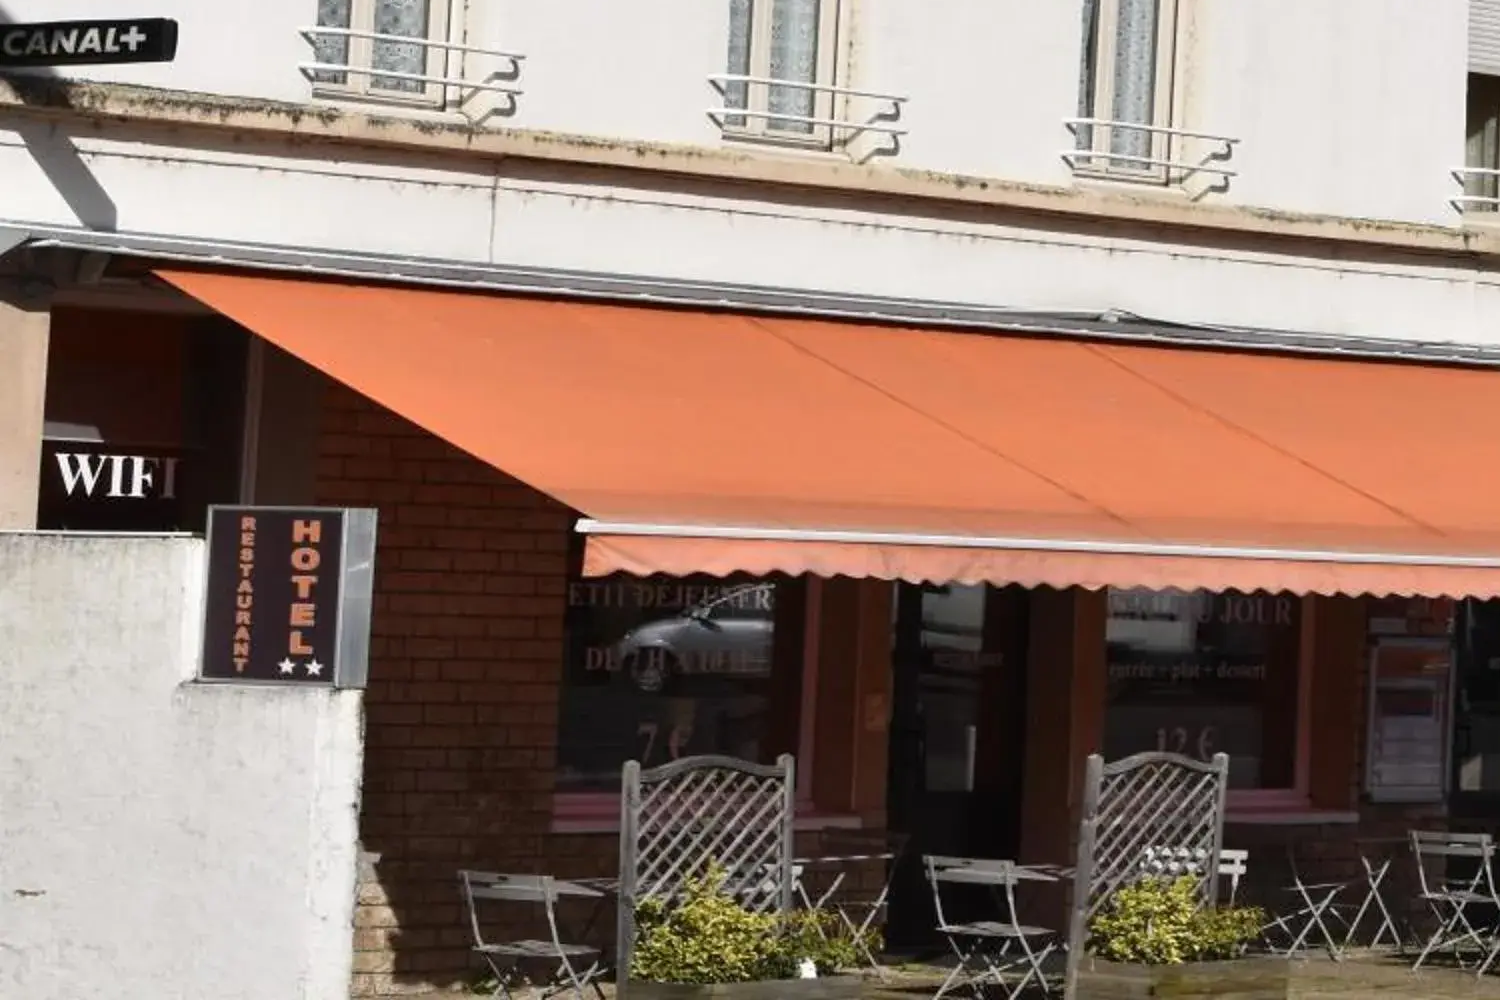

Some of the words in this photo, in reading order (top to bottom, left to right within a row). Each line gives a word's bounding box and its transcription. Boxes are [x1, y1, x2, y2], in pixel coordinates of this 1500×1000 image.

[3, 26, 147, 56] CANAL+
[54, 452, 182, 499] WIFI
[233, 516, 257, 673] RESTAURANT
[289, 519, 322, 655] HOTEL
